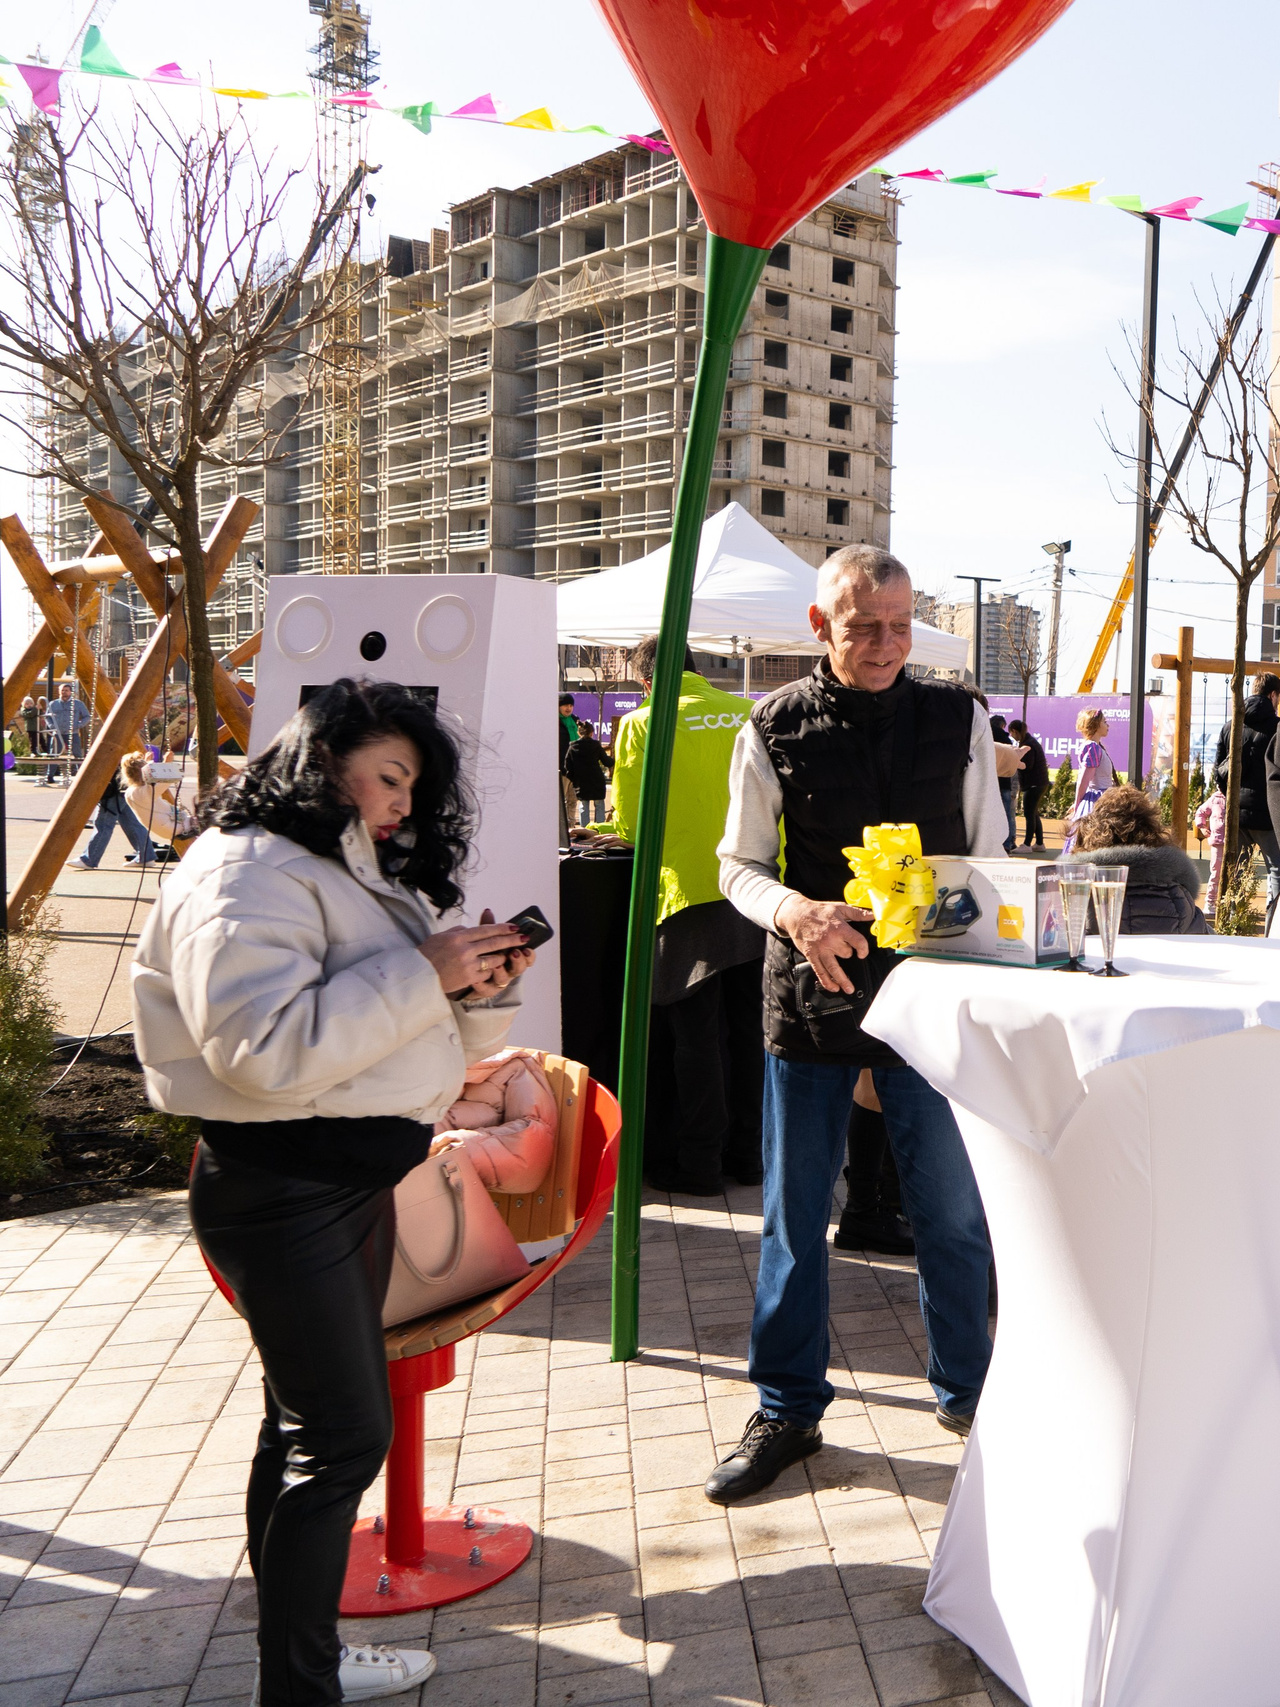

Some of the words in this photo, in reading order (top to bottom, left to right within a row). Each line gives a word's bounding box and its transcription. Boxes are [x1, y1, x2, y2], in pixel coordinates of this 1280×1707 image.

[594, 722, 613, 736] ПАР
[991, 874, 1015, 883] STEAM
[1015, 876, 1032, 884] IRON
